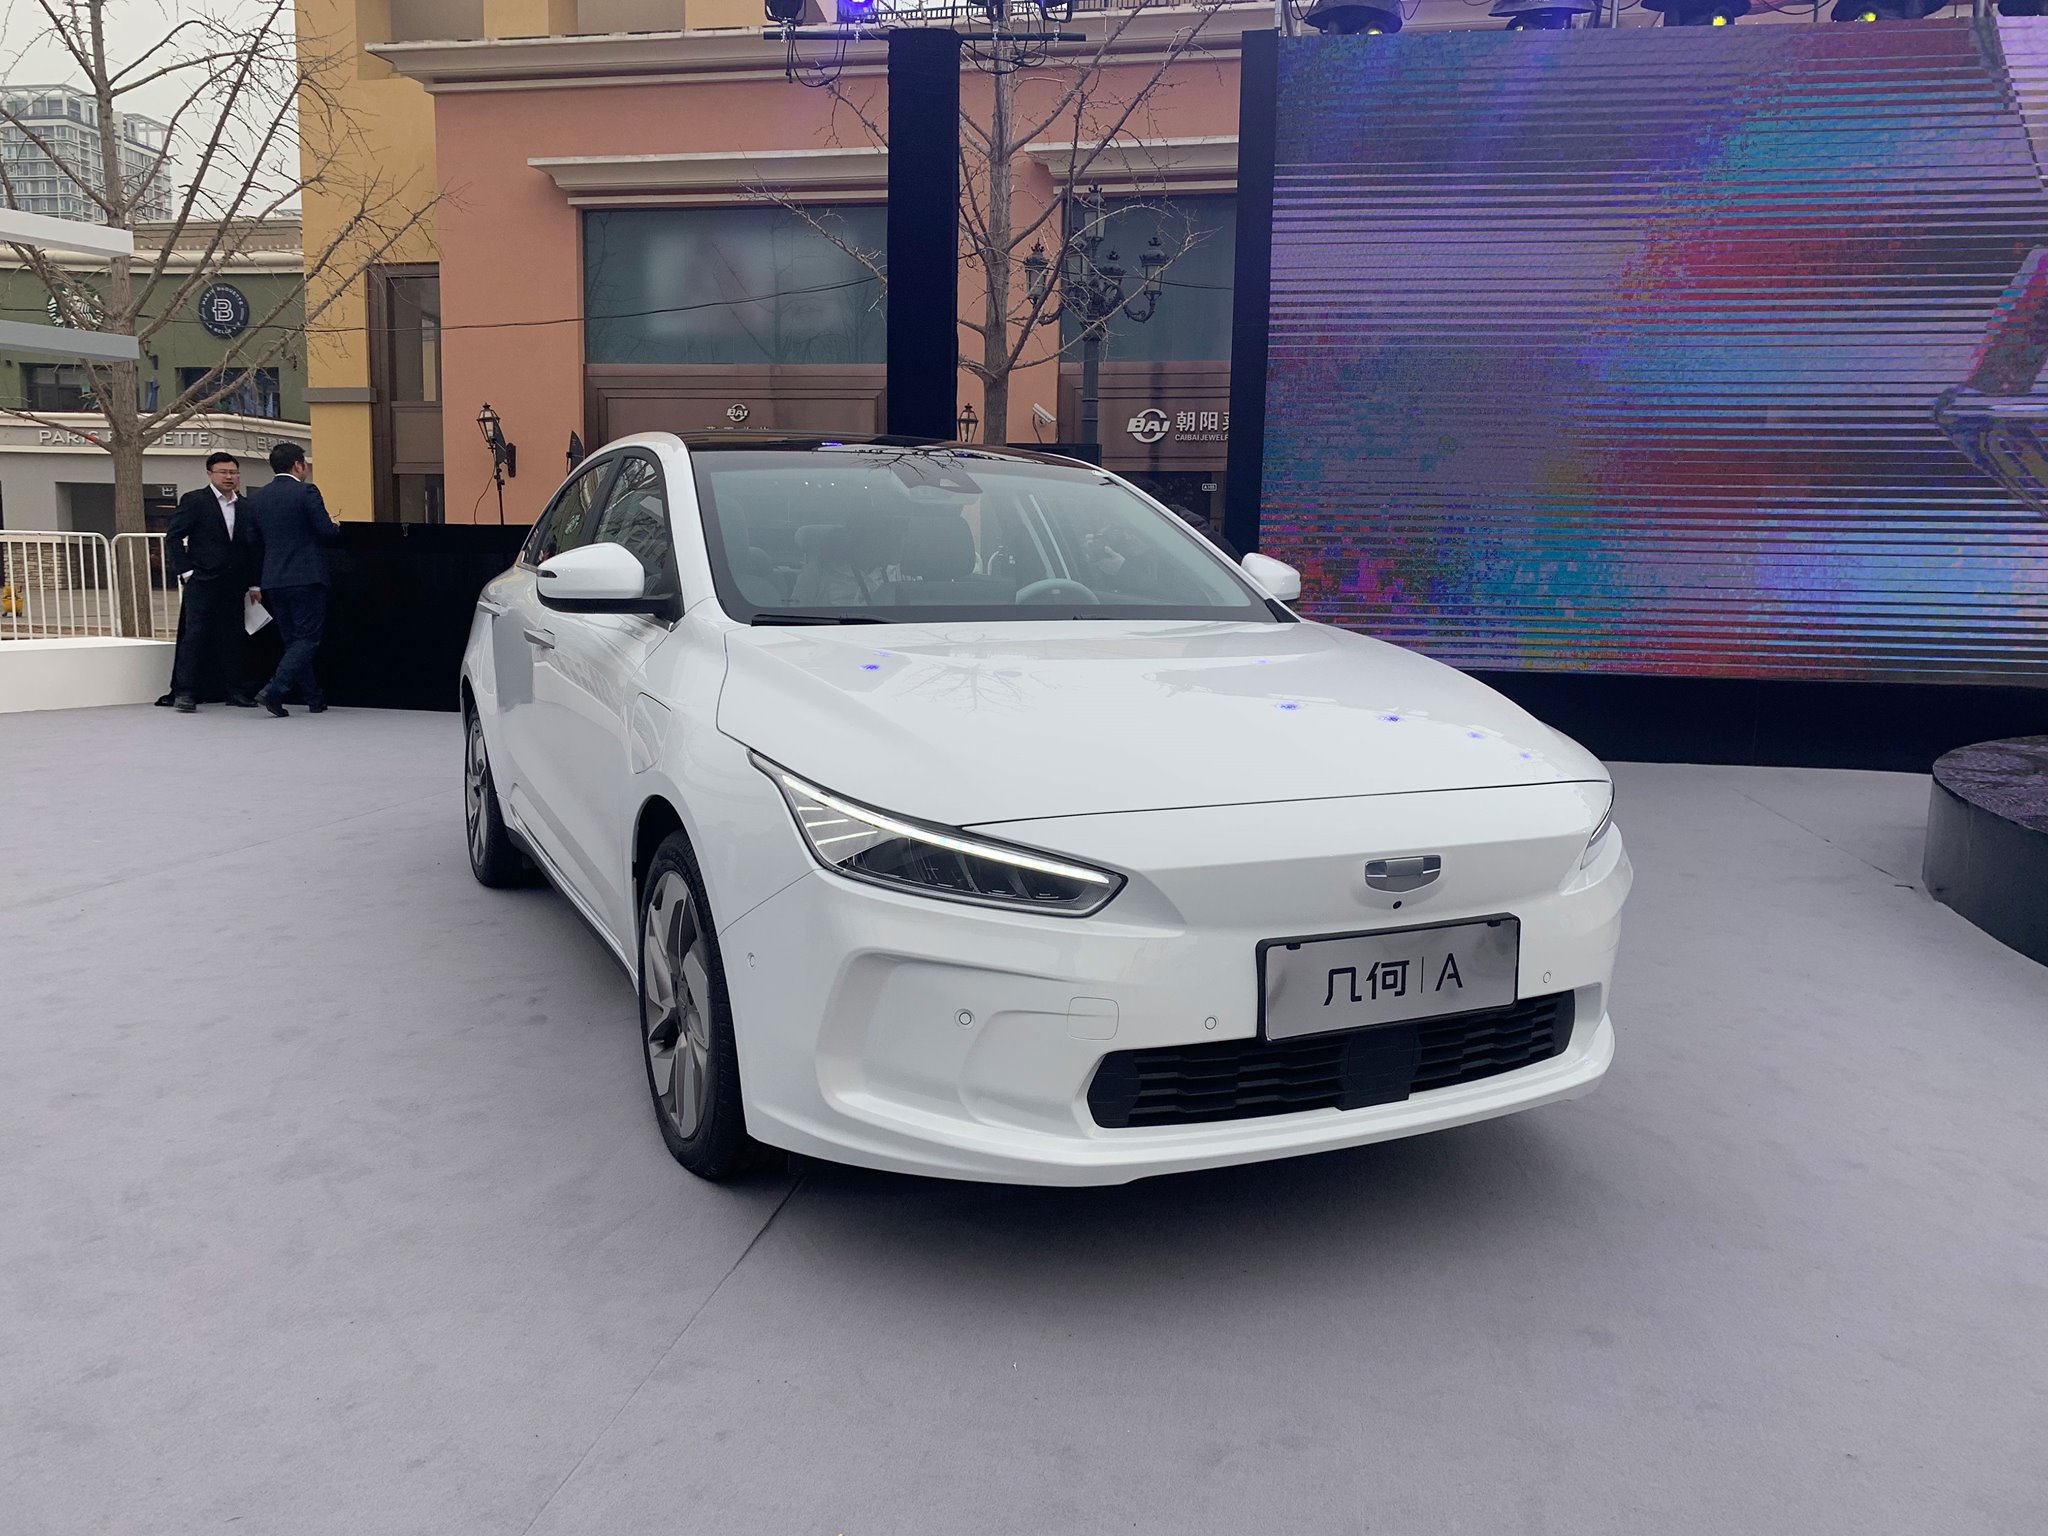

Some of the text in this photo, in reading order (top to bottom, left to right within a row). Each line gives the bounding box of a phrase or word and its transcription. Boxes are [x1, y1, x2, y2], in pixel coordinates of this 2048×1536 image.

[1126, 417, 1171, 432] BAI
[107, 431, 210, 445] ETTE
[1323, 952, 1464, 1007] 几何 A
